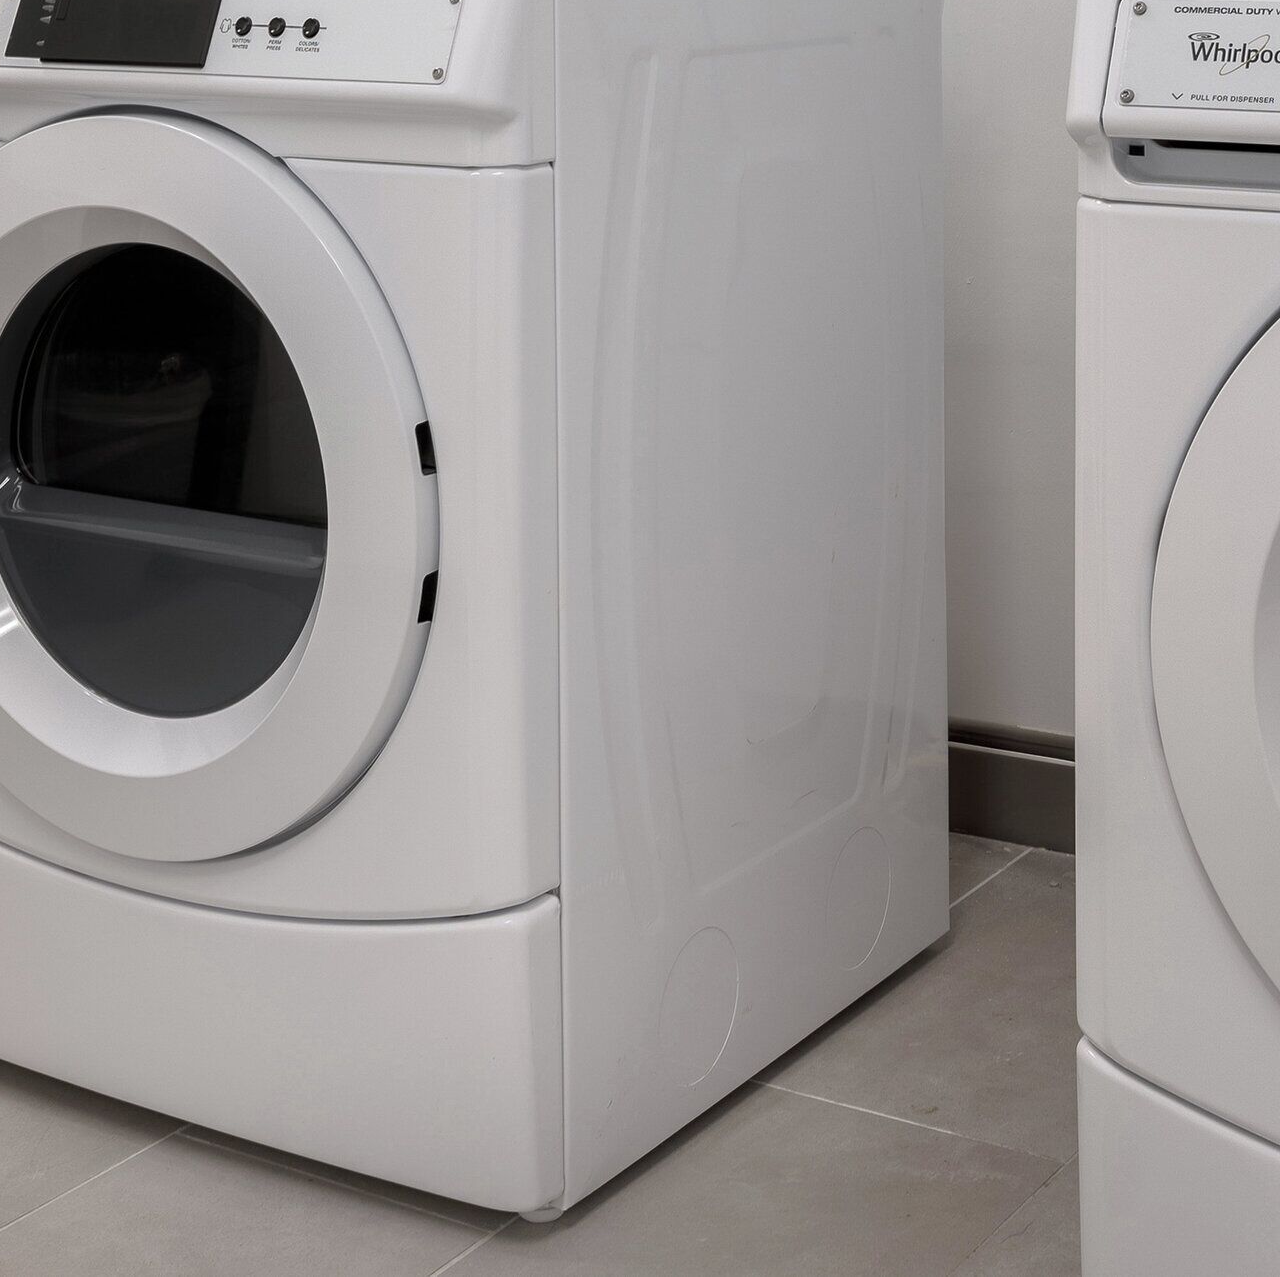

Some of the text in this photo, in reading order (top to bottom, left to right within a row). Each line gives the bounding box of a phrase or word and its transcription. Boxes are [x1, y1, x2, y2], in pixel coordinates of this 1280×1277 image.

[1174, 6, 1243, 15] COMMERCIAL
[1246, 7, 1274, 15] DUTY
[1190, 93, 1275, 104] PULL FOR DISPENSER
